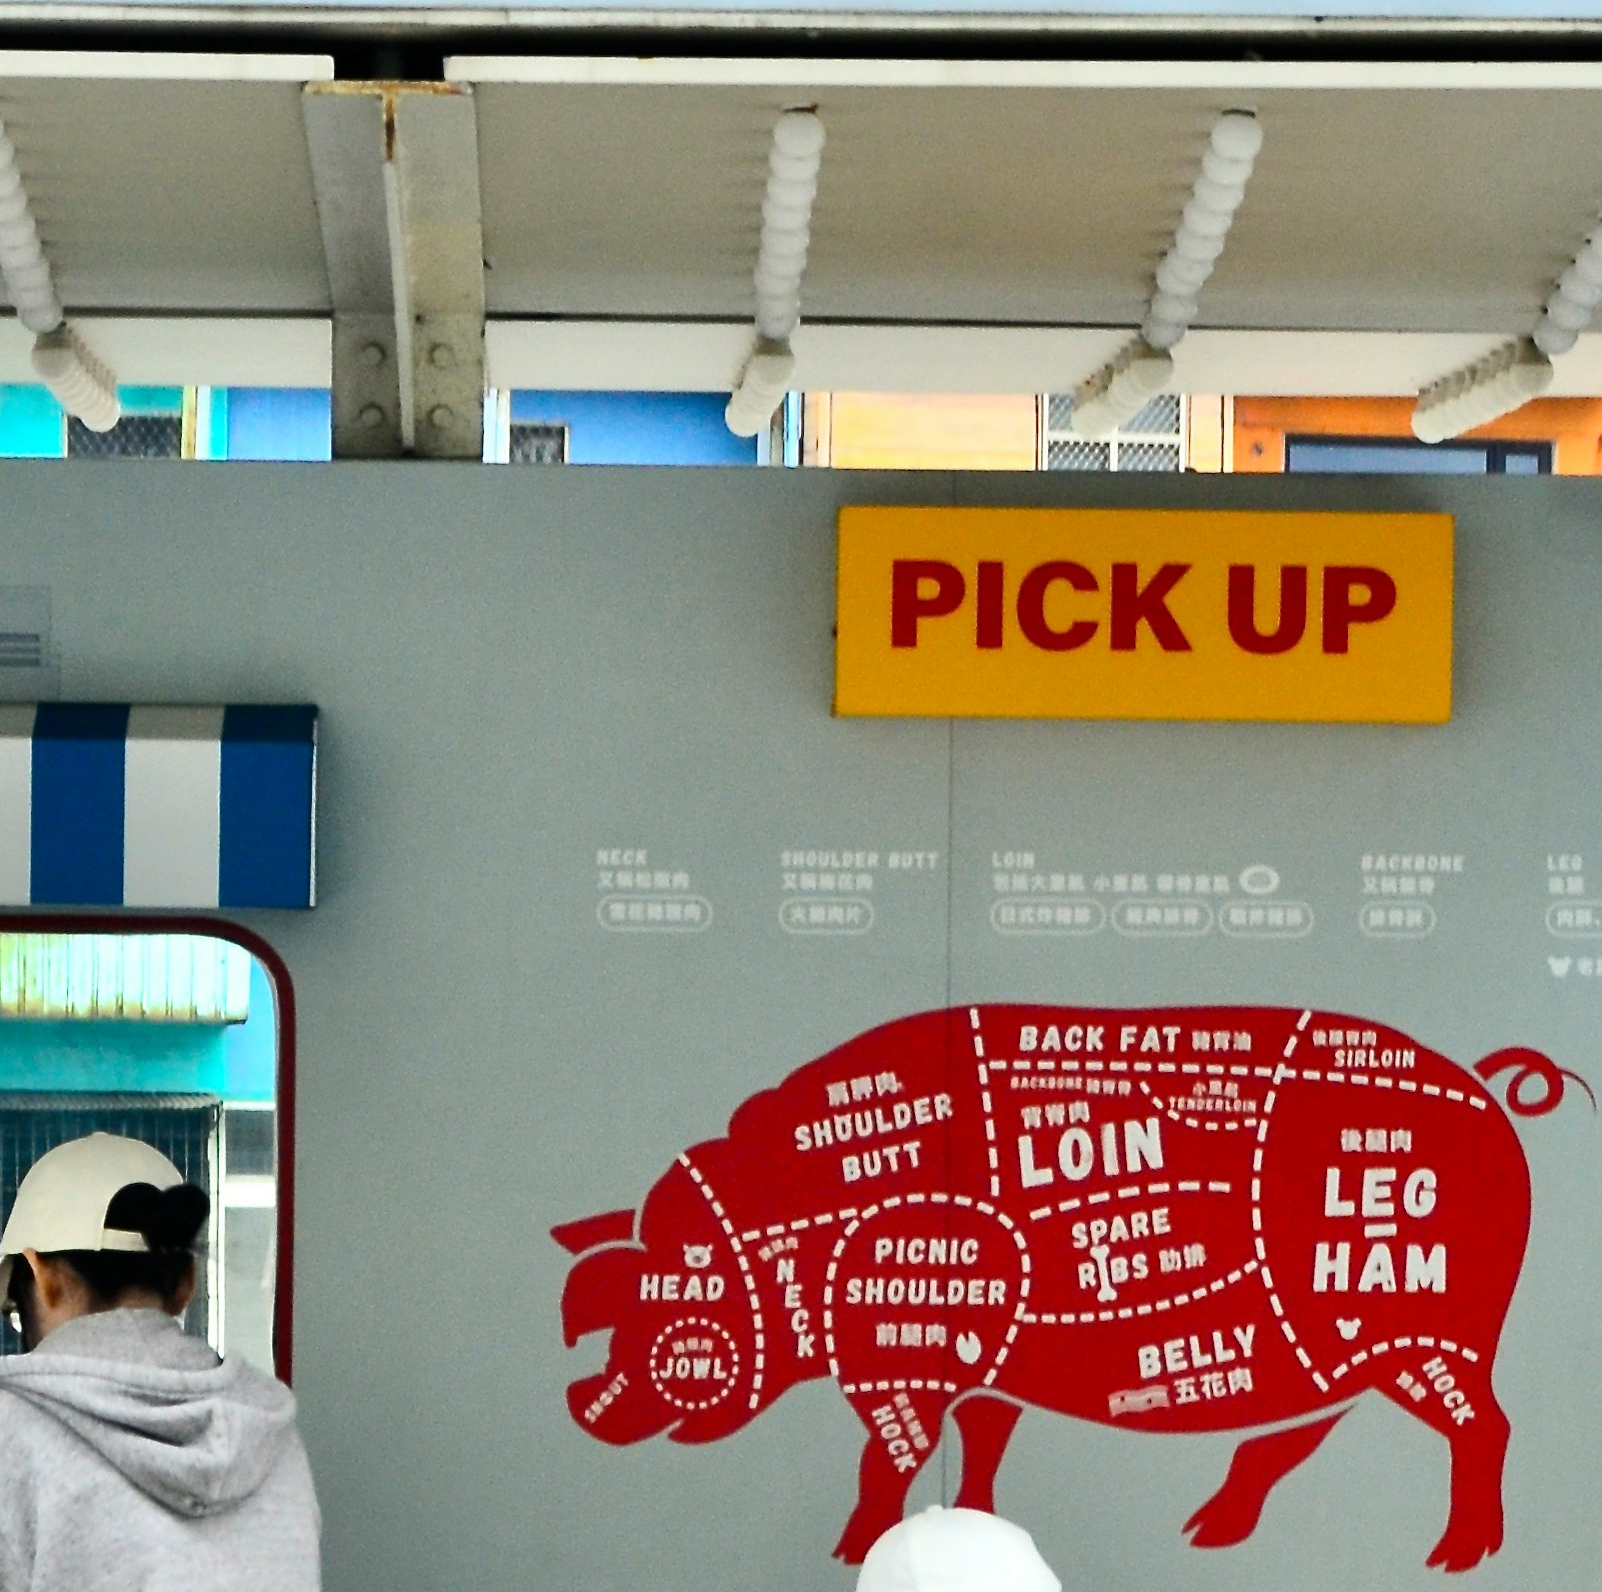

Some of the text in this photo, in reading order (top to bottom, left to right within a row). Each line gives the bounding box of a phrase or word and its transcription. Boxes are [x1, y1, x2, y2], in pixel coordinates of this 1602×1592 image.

[891, 560, 1397, 655] PICK UP
[992, 851, 1035, 869] LOIN
[1019, 1025, 1104, 1051] BACK
[1120, 1026, 1181, 1052] FAT
[1334, 1049, 1416, 1068] SIRLOIN
[794, 1093, 953, 1151] SHOULDER
[842, 1141, 921, 1182] BUTT
[1018, 1117, 1164, 1188] LOIN
[1325, 1166, 1437, 1218] LEG
[1071, 1207, 1171, 1249] SPARE
[875, 1238, 979, 1265] PICNIC
[1077, 1245, 1149, 1302] RIBS
[1313, 1242, 1446, 1293] HAM
[640, 1274, 725, 1301] HEAD
[776, 1259, 815, 1358] NECK
[846, 1278, 1006, 1305] SHOULDER
[659, 1357, 727, 1379] JOWL
[1138, 1324, 1255, 1379] BELLY
[1173, 1368, 1254, 1405] 五花肉
[1422, 1357, 1475, 1426] HOCK
[872, 1405, 917, 1474] HOCK
